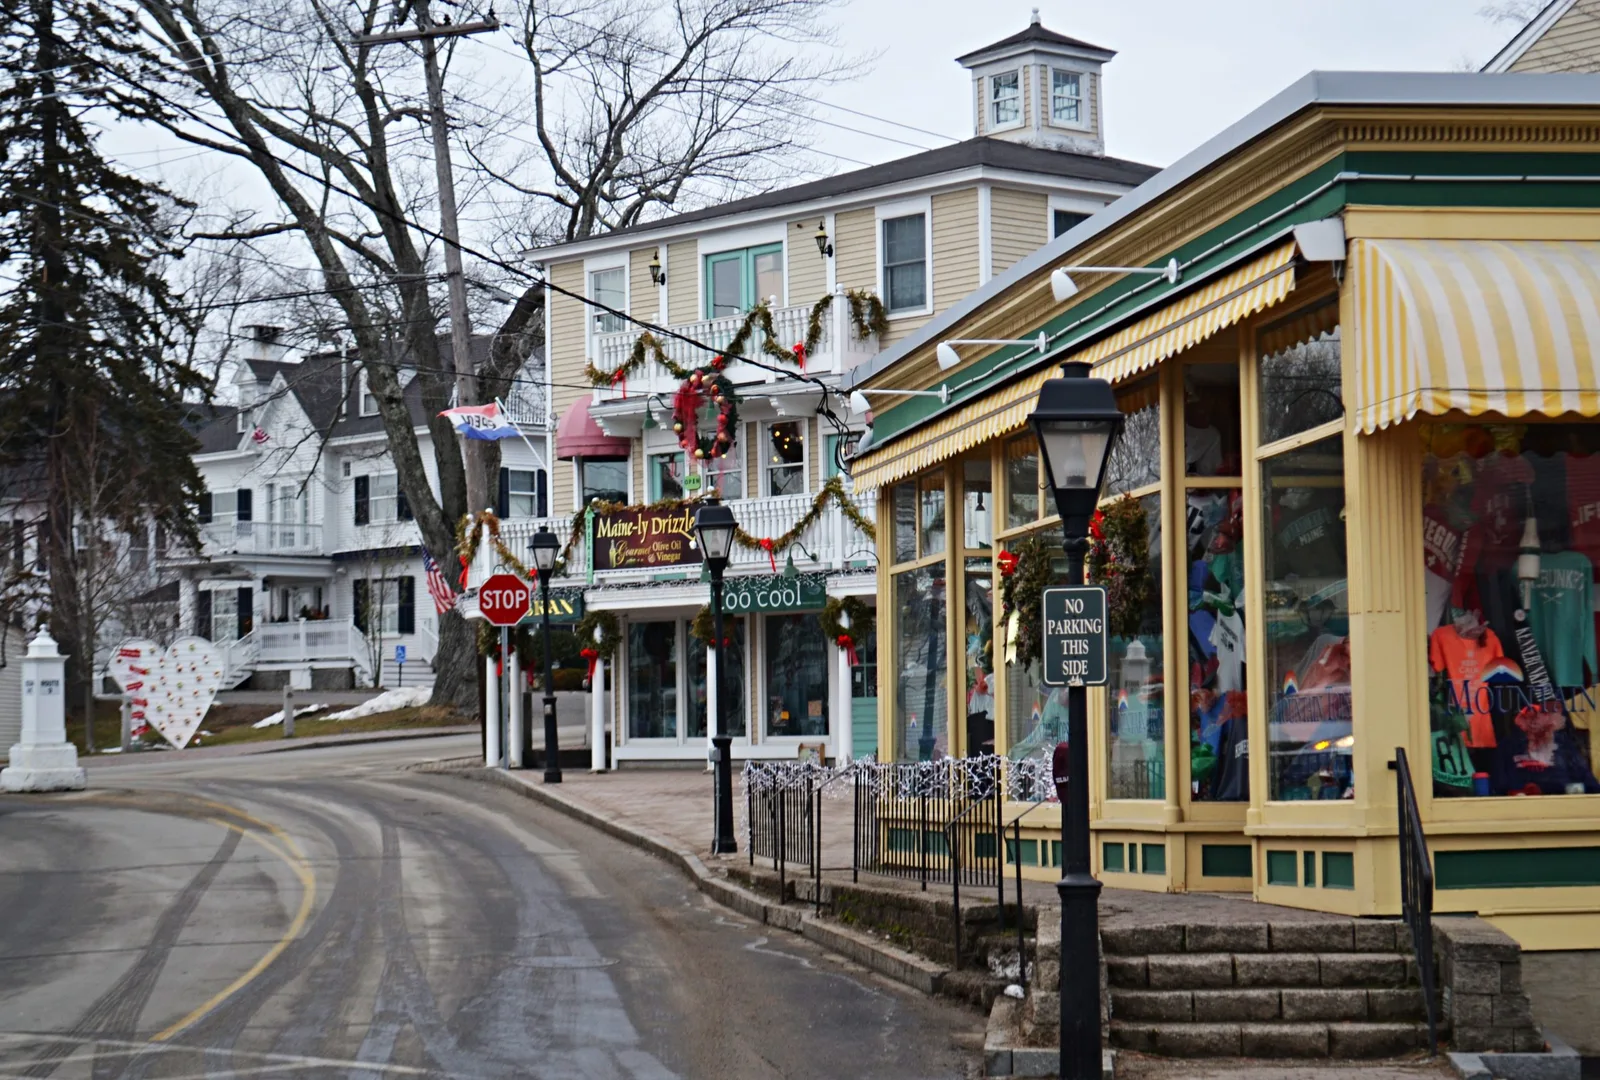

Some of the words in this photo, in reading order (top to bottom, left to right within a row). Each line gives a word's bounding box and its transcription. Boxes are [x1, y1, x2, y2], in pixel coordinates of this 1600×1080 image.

[597, 513, 649, 544] Maine-ly
[651, 508, 696, 538] Drizzle
[615, 540, 652, 564] Gourmet
[652, 541, 669, 552] Olive
[671, 540, 682, 550] Oil
[656, 552, 681, 563] Vinegar
[482, 590, 527, 609] STOP
[757, 580, 801, 606] cool
[1065, 598, 1084, 614] NO
[1048, 618, 1102, 635] PARKING
[1061, 639, 1089, 655] THIS
[1062, 660, 1089, 675] SIDE
[1445, 680, 1599, 716] MOUNTAIN
